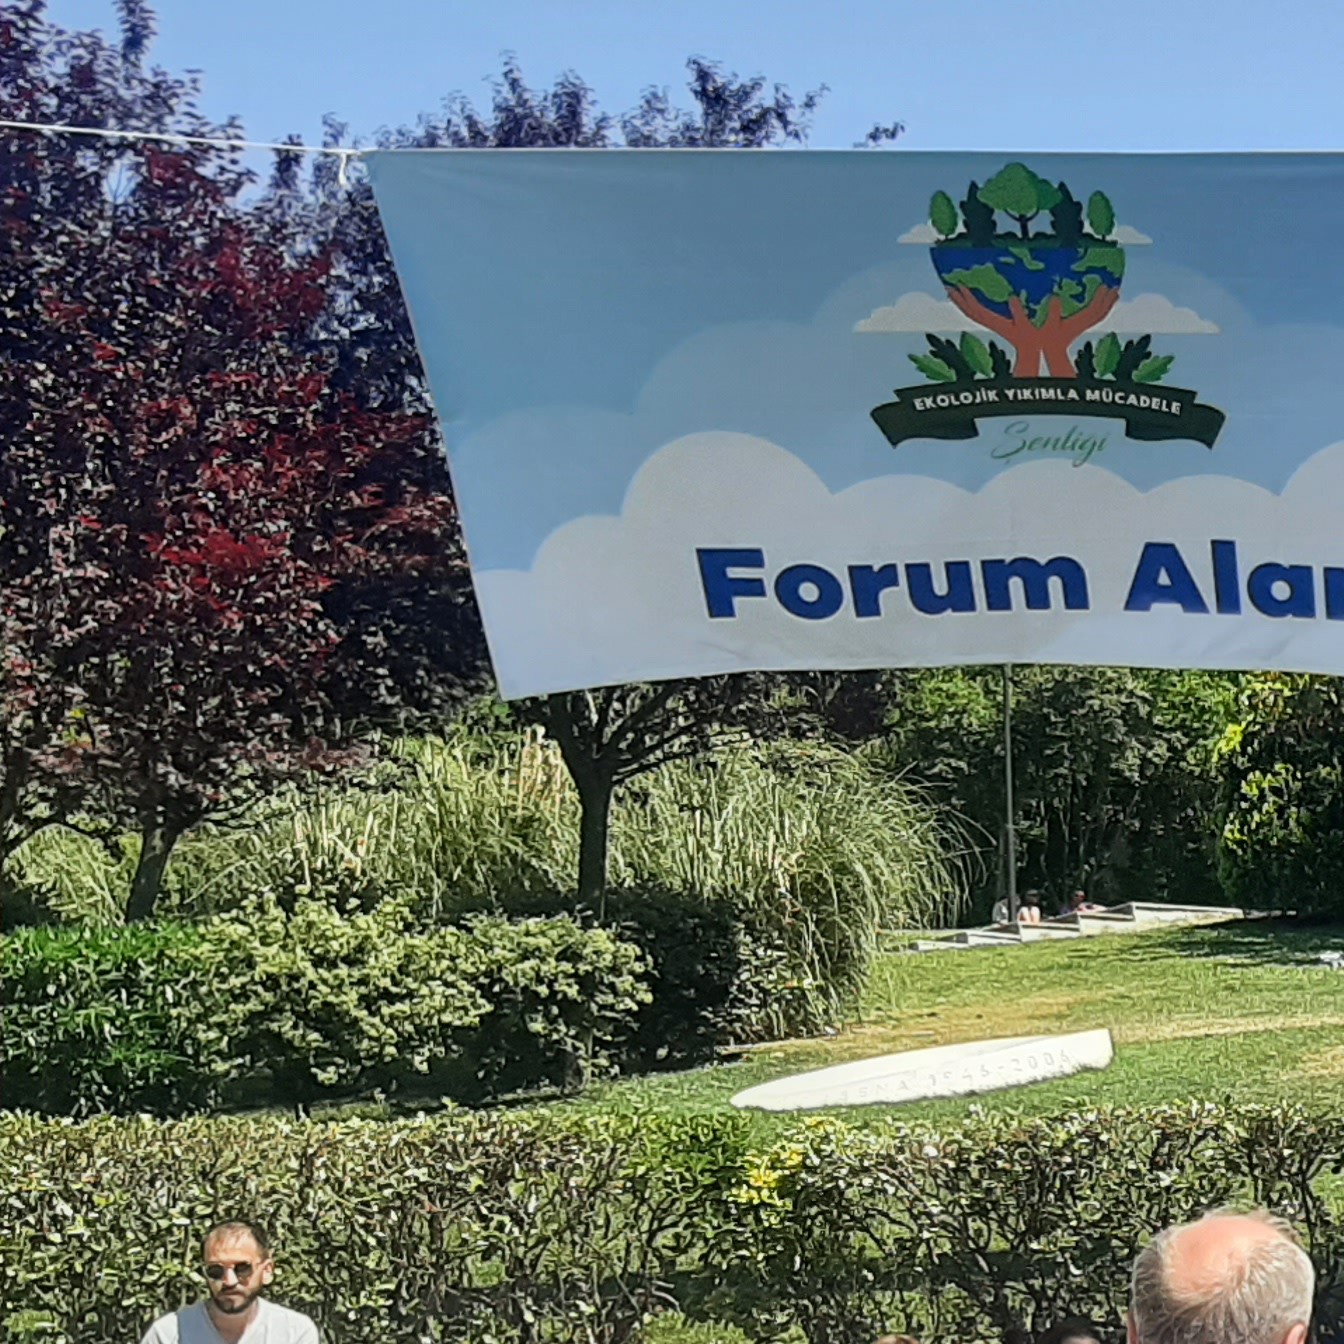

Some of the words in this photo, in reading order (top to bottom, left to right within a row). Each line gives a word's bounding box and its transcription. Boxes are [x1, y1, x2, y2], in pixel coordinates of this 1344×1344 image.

[914, 387, 1000, 411] EKOLOJİK
[1004, 388, 1081, 401] YIKIMLA
[1085, 388, 1182, 416] MÜCADELE
[695, 547, 1091, 620] Forum
